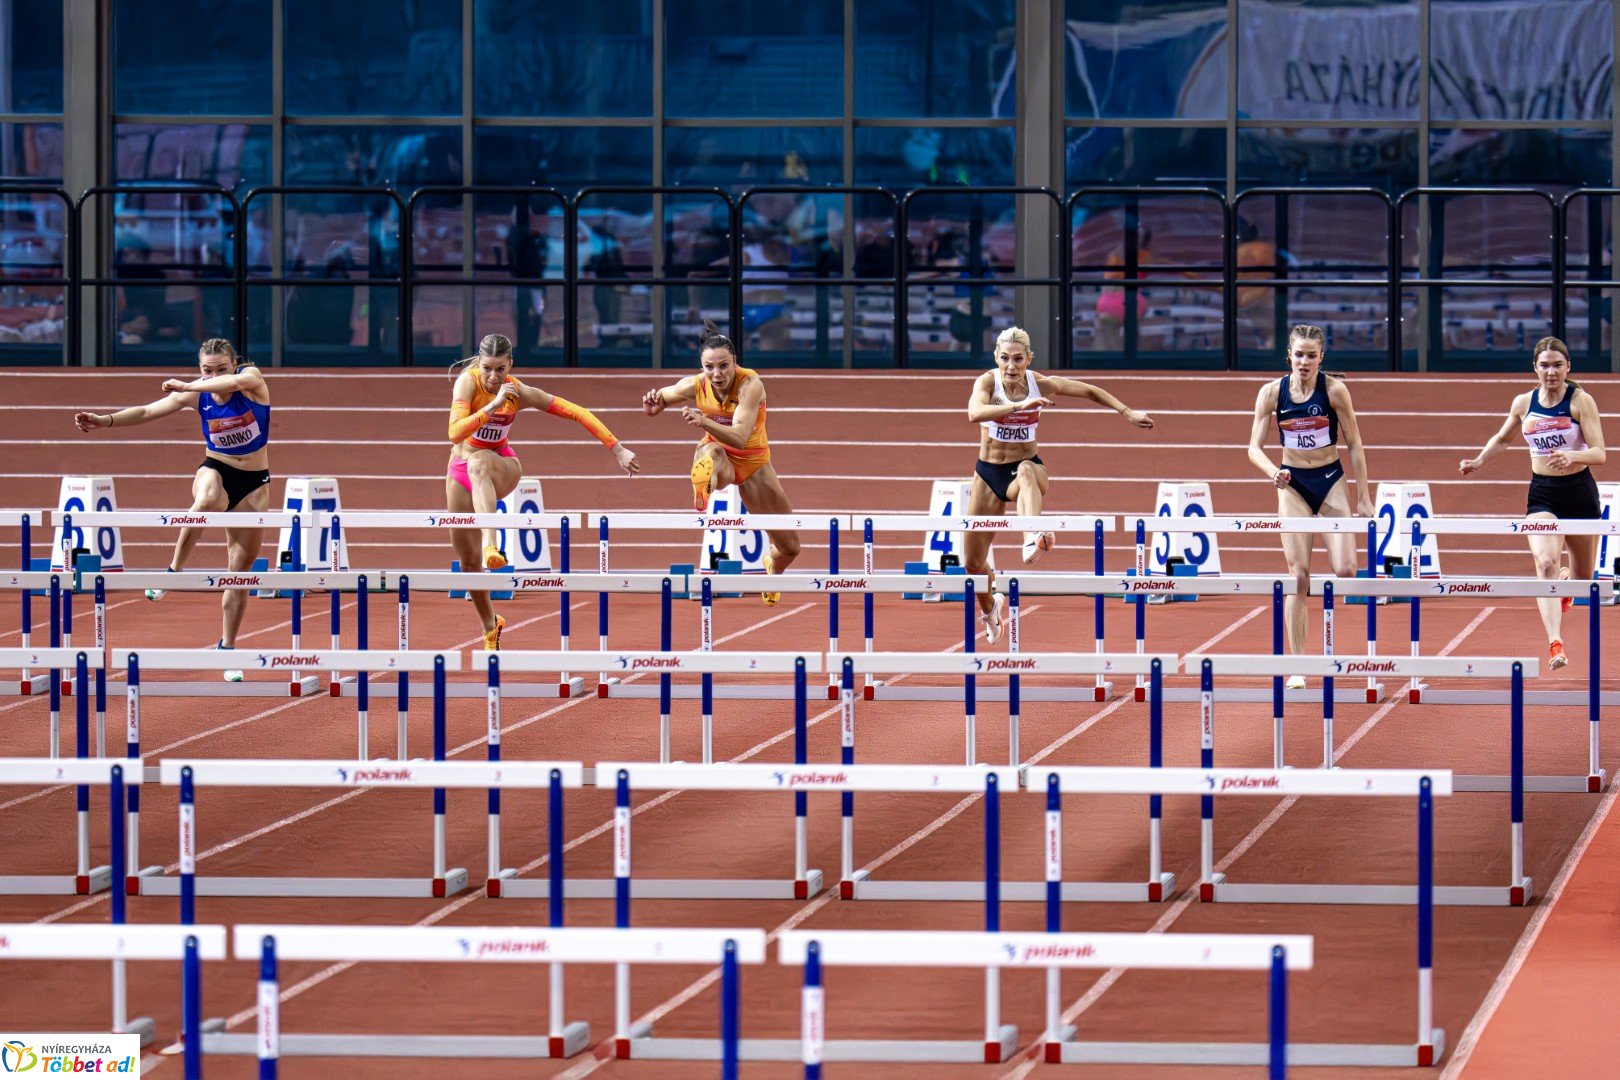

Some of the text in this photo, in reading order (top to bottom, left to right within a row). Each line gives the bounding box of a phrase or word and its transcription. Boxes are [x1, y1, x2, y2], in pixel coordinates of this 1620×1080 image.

[219, 429, 252, 447] BANKÓ
[1297, 433, 1316, 448] ÁCS
[1533, 434, 1567, 450] BACSA
[171, 515, 207, 525] polanik
[438, 516, 476, 526] polanik
[708, 517, 745, 528] polanik
[972, 519, 1009, 530] polanik
[1245, 521, 1282, 531] polanik
[97, 497, 116, 560] 8
[312, 498, 336, 562] 7
[519, 500, 542, 562] 6
[930, 502, 953, 555] 4
[1156, 502, 1172, 565] 3
[1521, 522, 1558, 532] polanik
[1184, 503, 1210, 565] 3
[1376, 504, 1395, 566] 2
[218, 576, 260, 587] polanik
[522, 577, 564, 589] polanik
[825, 578, 867, 590] polanik
[1133, 580, 1175, 591] polanik
[1449, 583, 1491, 594] polanik
[271, 655, 320, 668] polanik
[632, 656, 681, 669] polanik
[987, 658, 1036, 671] polanik
[1347, 661, 1396, 674] polanik
[353, 768, 412, 784] polanik
[790, 771, 849, 788] polanik
[1221, 775, 1280, 792] polanik
